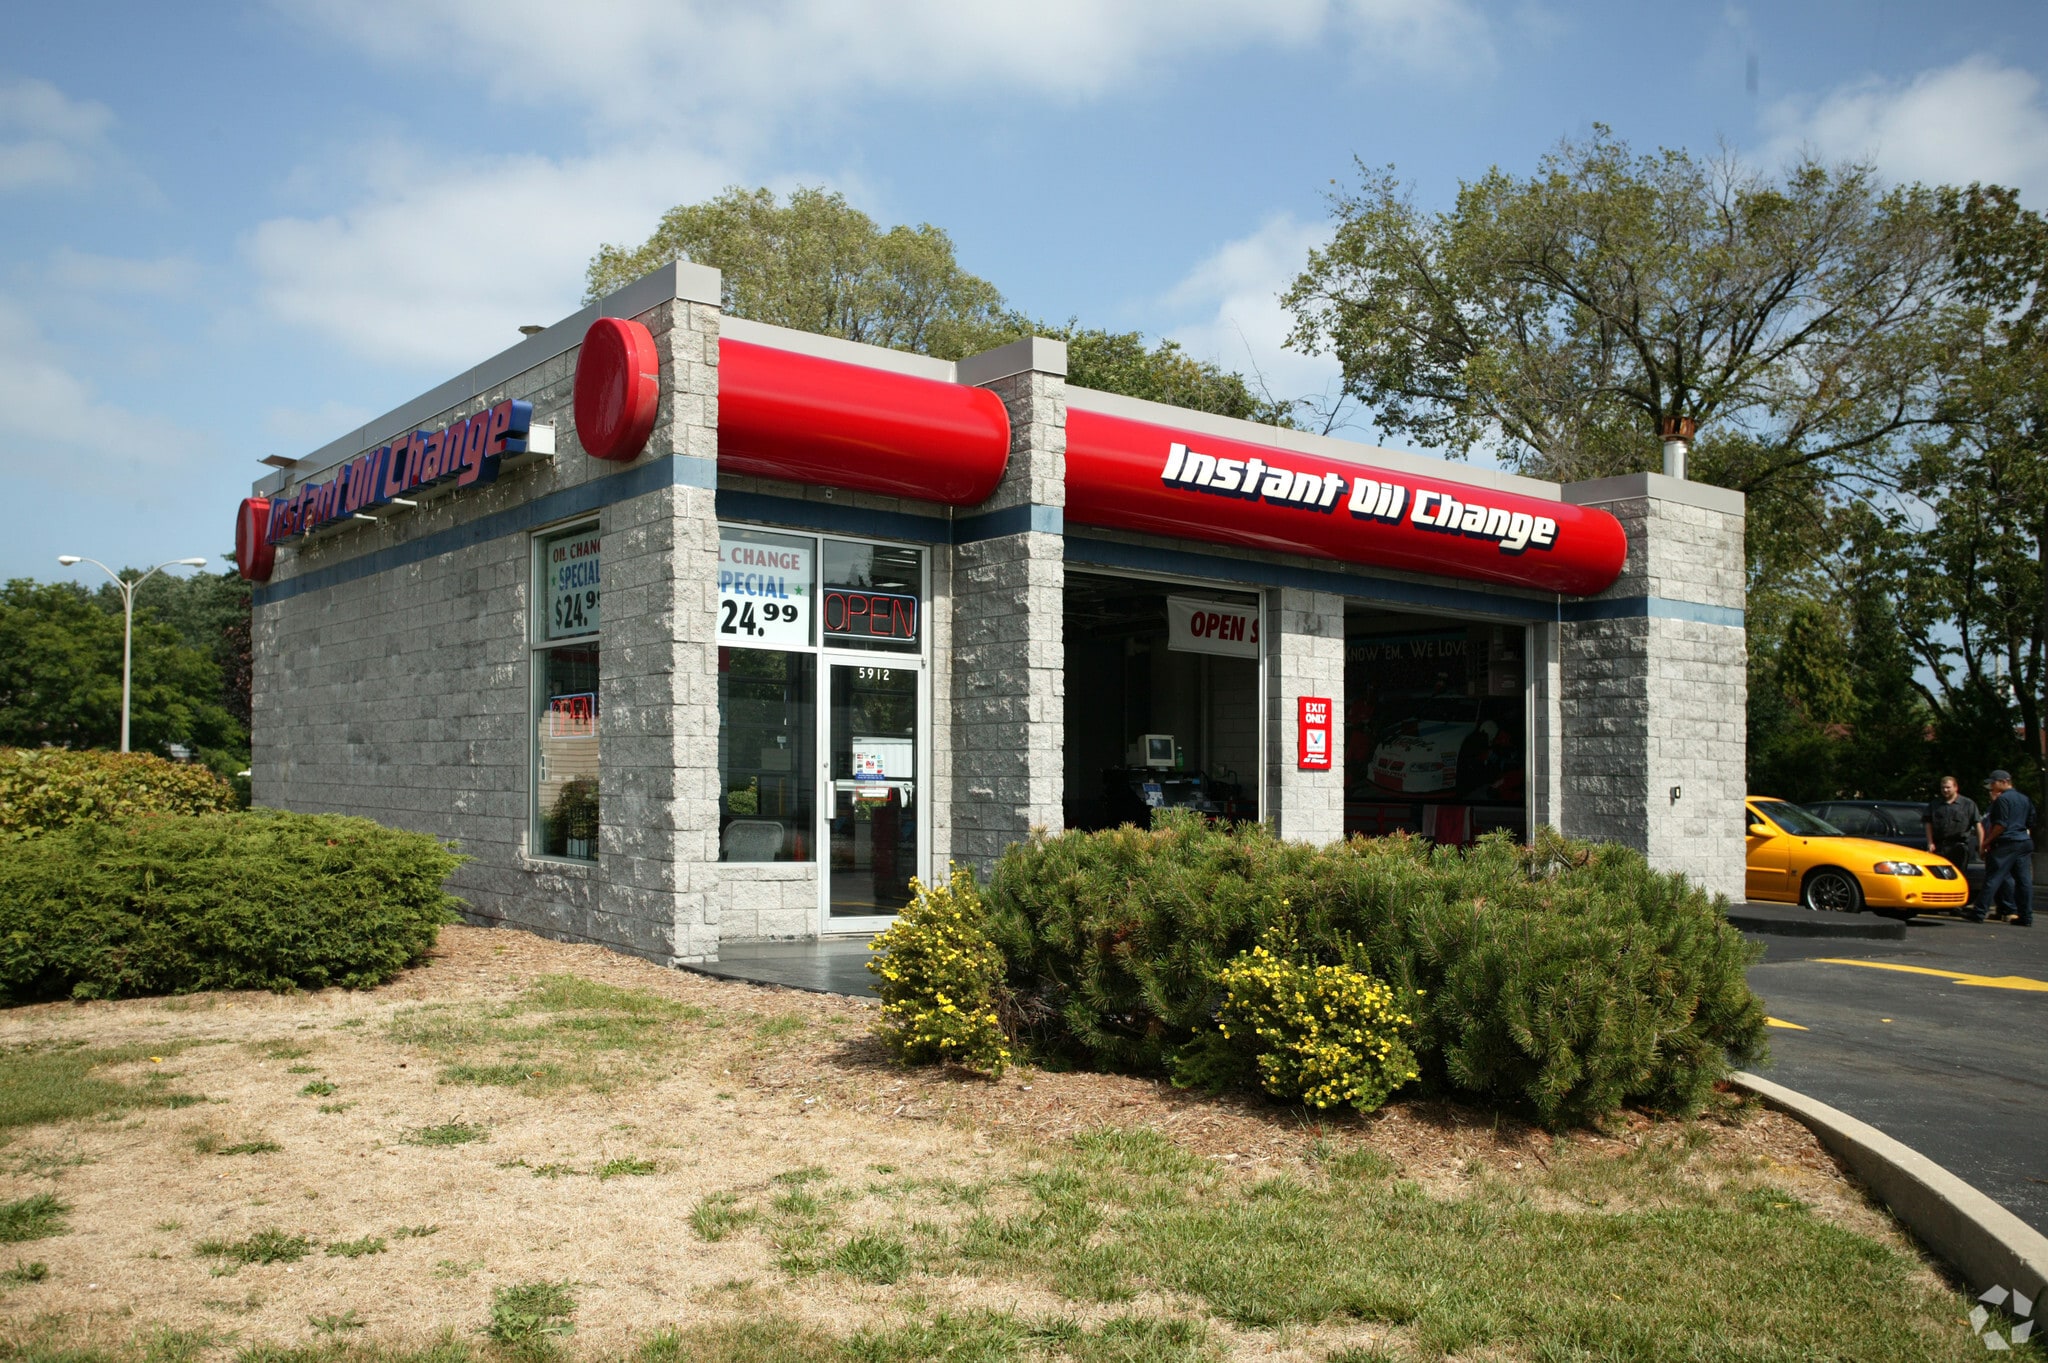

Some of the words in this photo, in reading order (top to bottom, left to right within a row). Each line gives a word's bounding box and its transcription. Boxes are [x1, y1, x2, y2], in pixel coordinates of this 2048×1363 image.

[264, 464, 347, 545] Instant
[345, 447, 388, 514] Oil
[383, 399, 518, 488] Change
[1161, 442, 1346, 511] Instant
[1347, 477, 1408, 522] Oil
[1410, 489, 1558, 551] Change
[553, 546, 567, 563] OIL
[569, 539, 600, 560] CHAN
[731, 547, 800, 570] CHANGE
[558, 559, 600, 591] SPECIAL
[717, 570, 789, 599] PECIAL
[824, 593, 914, 637] OPEN
[1190, 611, 1246, 642] OPEN
[1438, 638, 1468, 657] LOVE
[858, 667, 891, 681] 5912
[552, 697, 593, 737] OPEN
[1305, 702, 1326, 713] EXIT
[1305, 713, 1326, 724] ONLY
